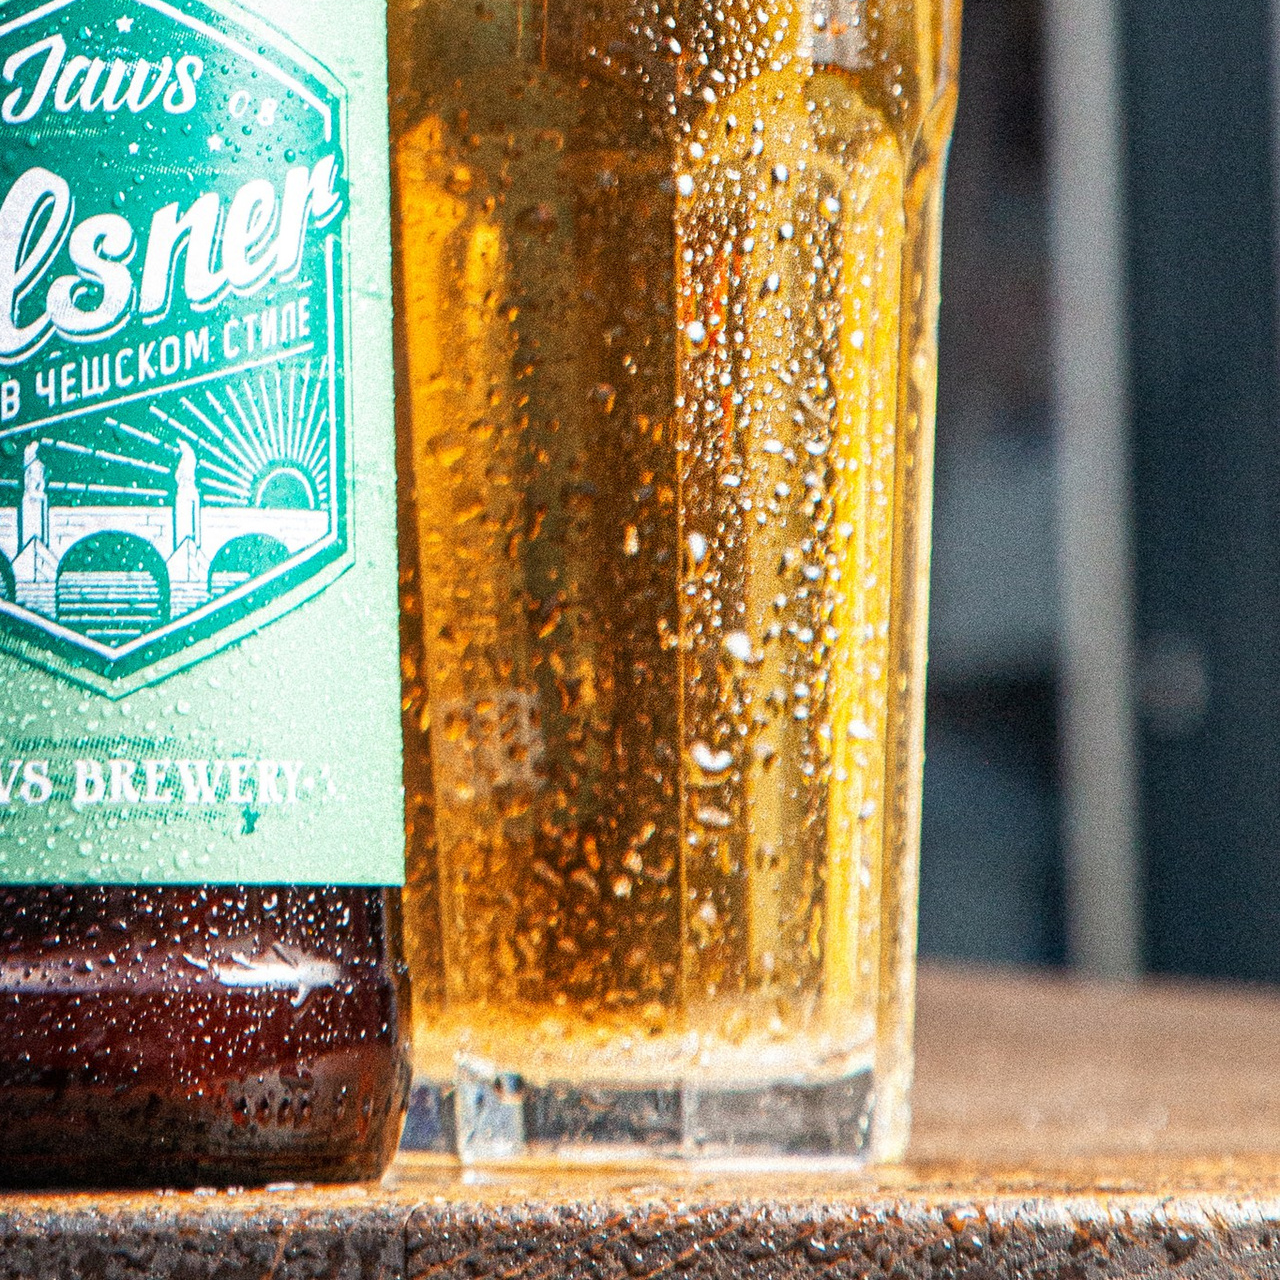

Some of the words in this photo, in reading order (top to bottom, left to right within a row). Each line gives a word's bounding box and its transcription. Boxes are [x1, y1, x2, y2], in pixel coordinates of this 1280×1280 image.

[0, 33, 204, 125] Jaws
[228, 89, 279, 127] 08
[0, 379, 21, 423] В
[34, 325, 211, 409] ЧЕШСКОМ
[222, 296, 312, 358] СТИЛЕ
[72, 757, 304, 806] BREWERY
